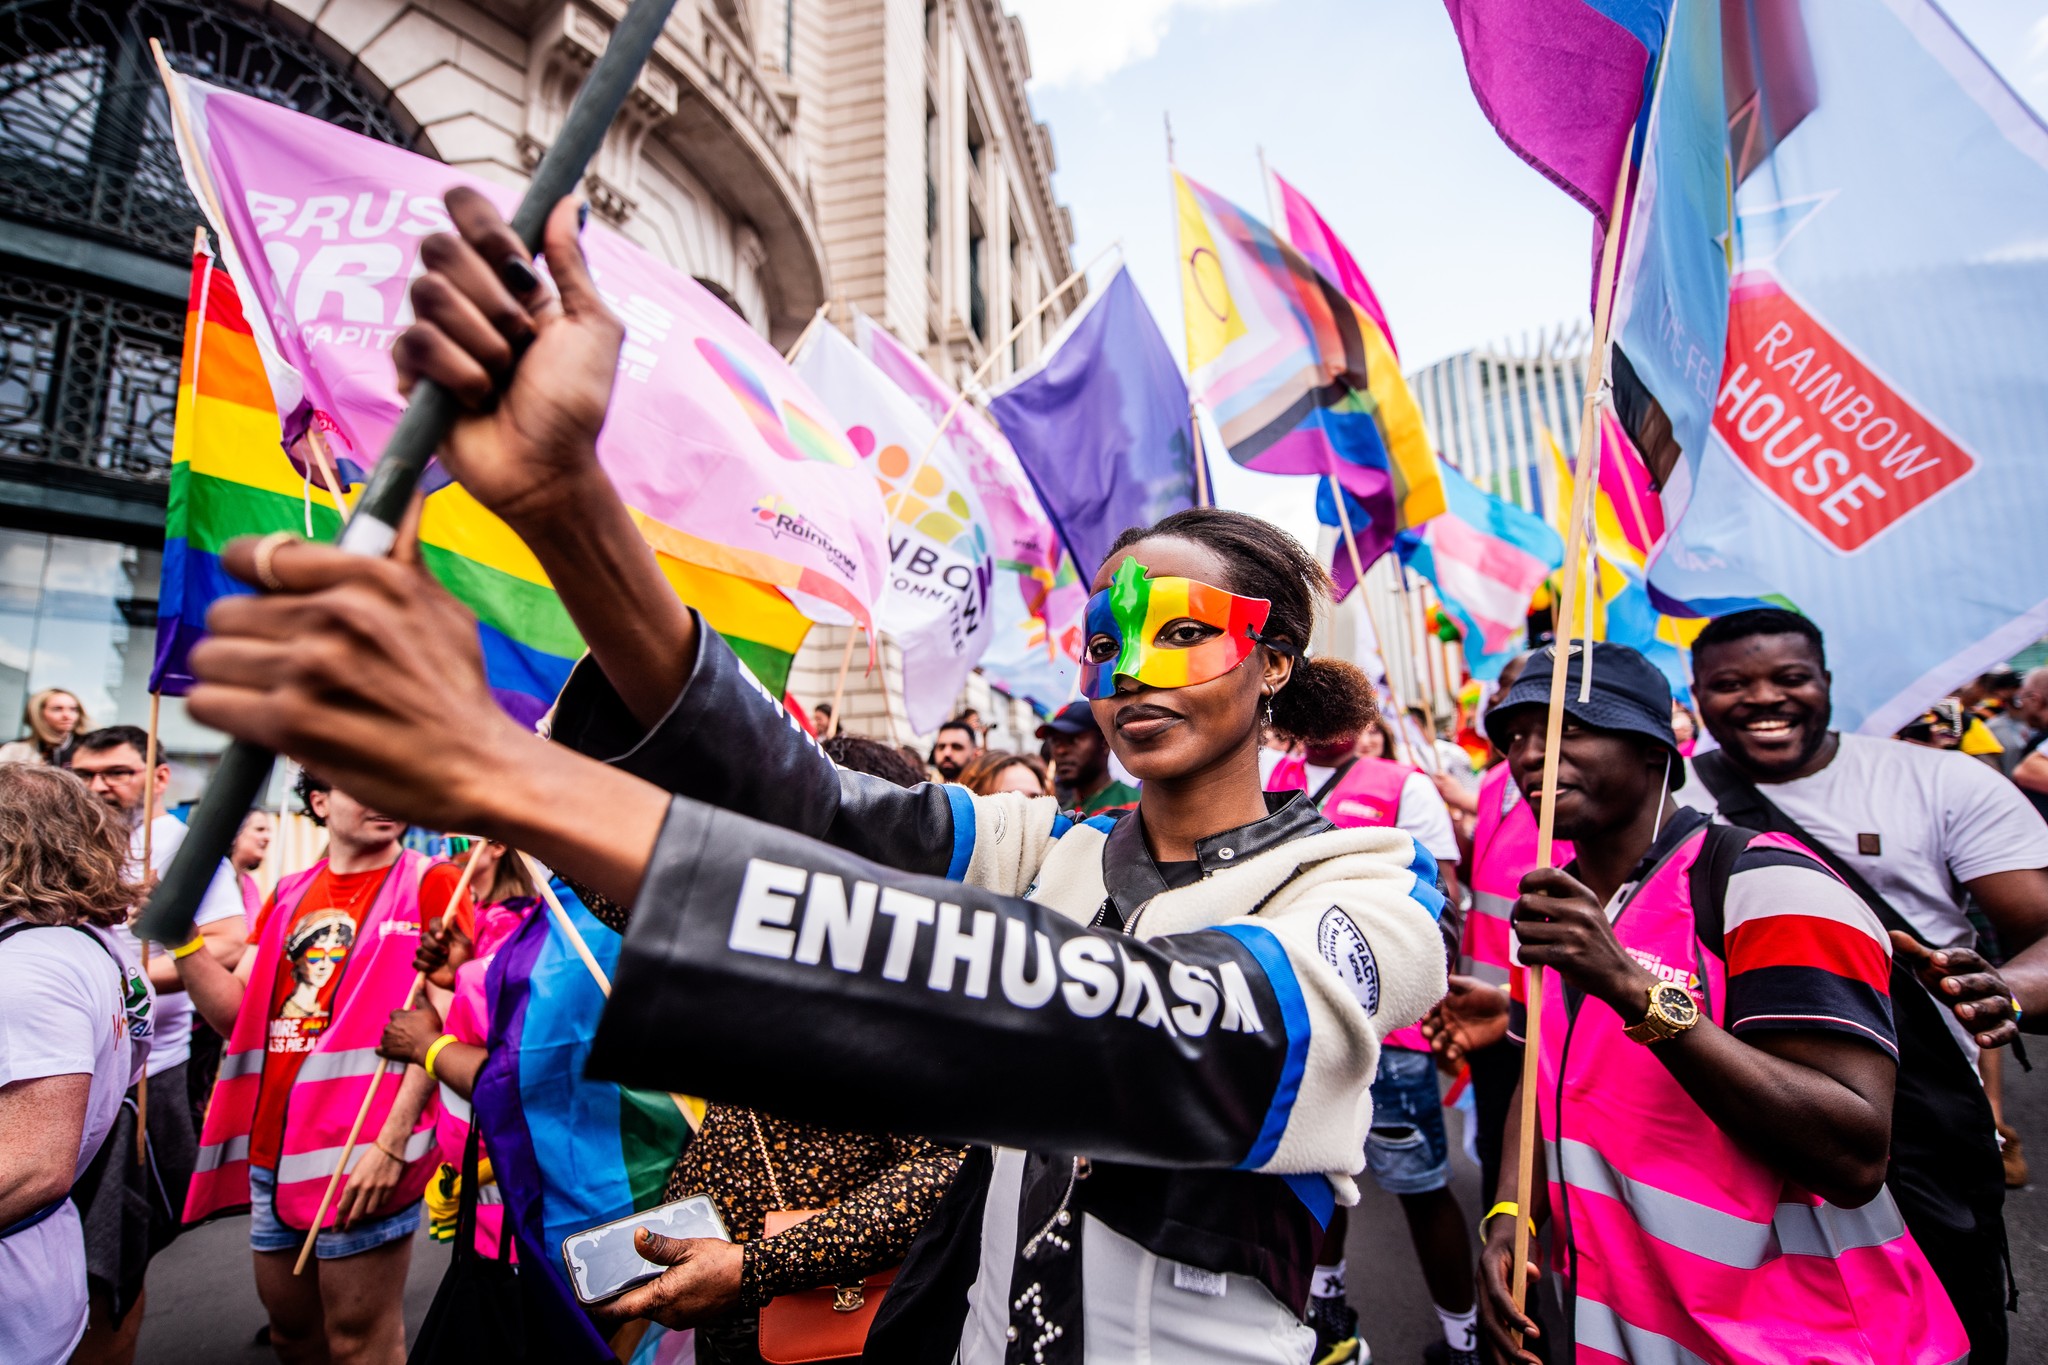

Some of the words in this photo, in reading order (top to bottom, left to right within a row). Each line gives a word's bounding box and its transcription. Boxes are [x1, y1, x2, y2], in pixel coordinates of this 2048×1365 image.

[1717, 362, 1887, 527] HOUSE
[1754, 320, 1941, 481] RAINBOW
[776, 513, 857, 571] Rainbow
[890, 572, 965, 656] OMMITTEE
